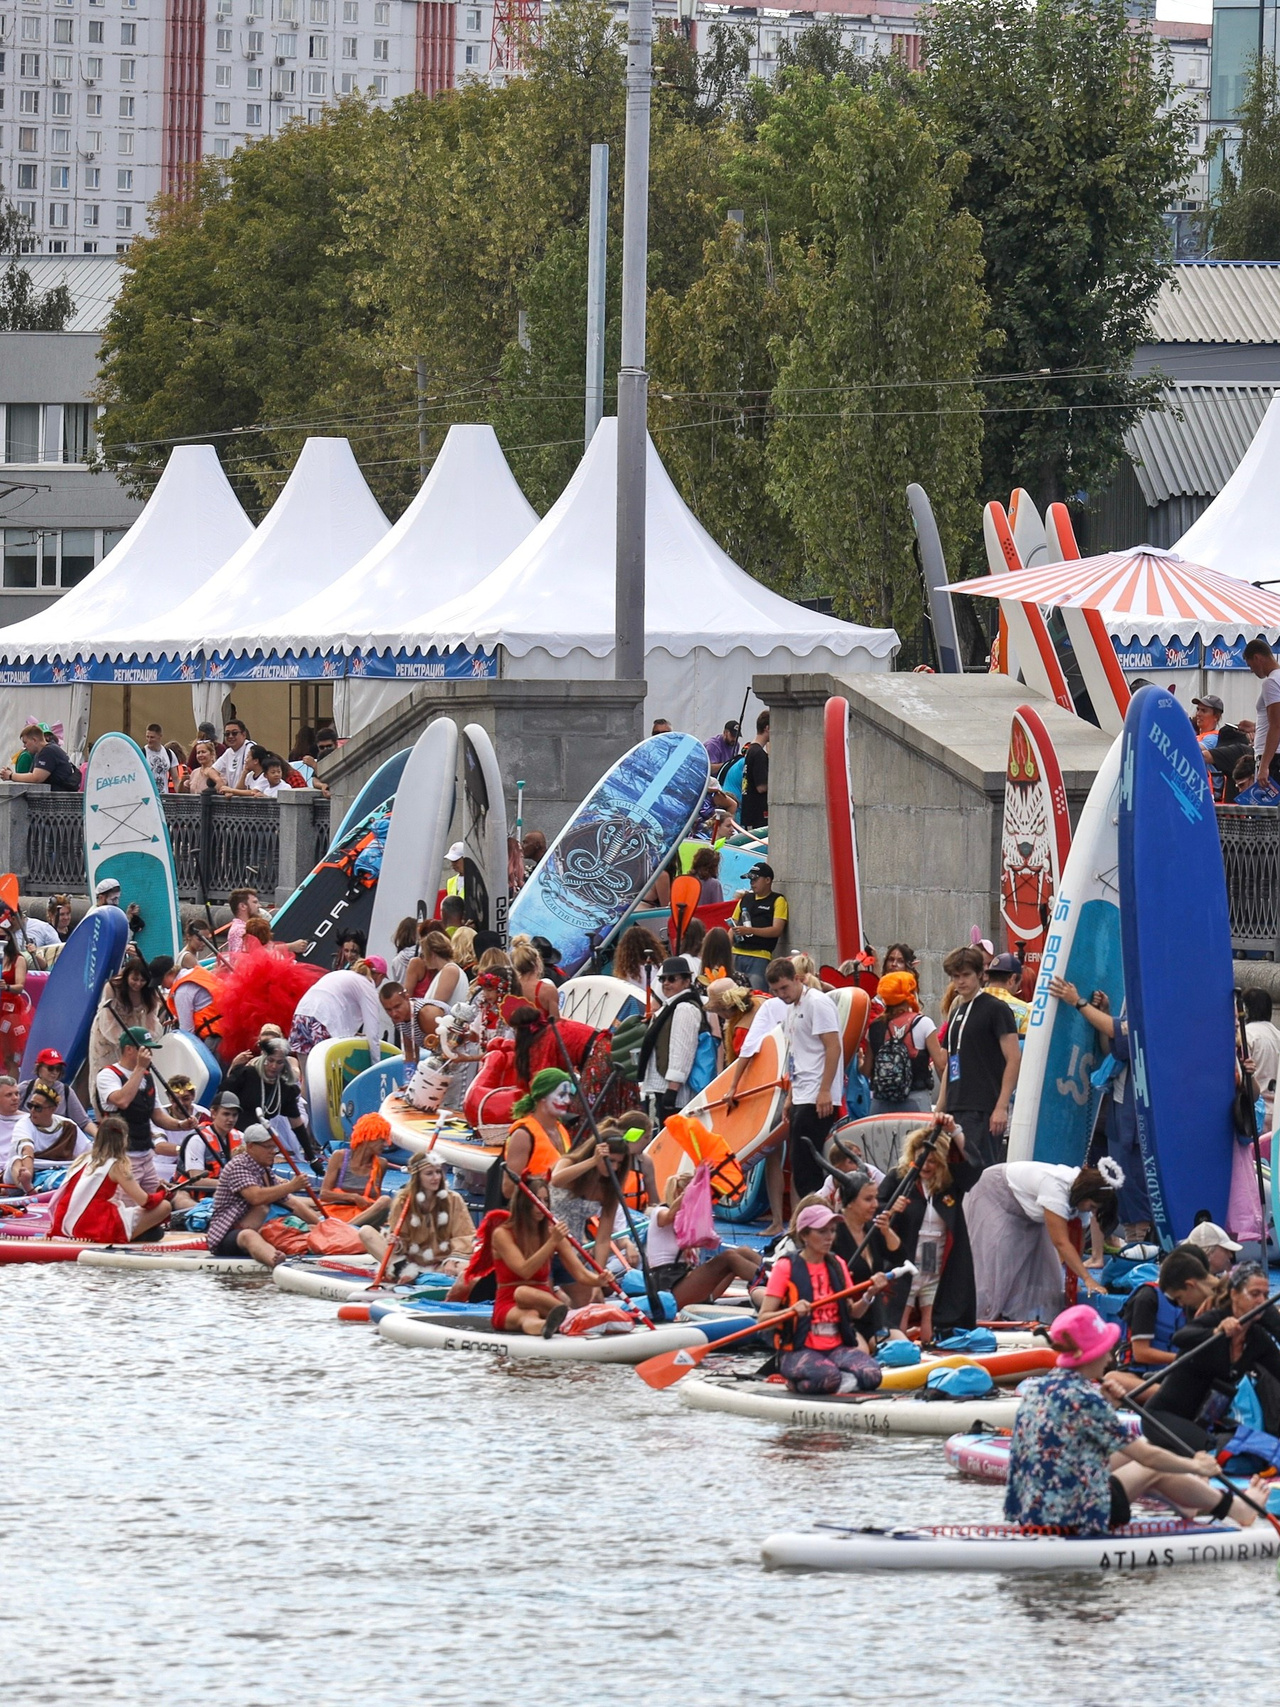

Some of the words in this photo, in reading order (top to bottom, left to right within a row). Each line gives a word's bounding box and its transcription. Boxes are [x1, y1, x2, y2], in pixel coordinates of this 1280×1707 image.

[113, 669, 158, 682] РЕГИСТРАЦИЯ
[395, 663, 445, 677] РЕГИСТРАЦИЯ
[1148, 721, 1210, 803] BRADEX
[1030, 934, 1062, 1027] BOARD
[1143, 1154, 1166, 1223] BRADEX
[1099, 1548, 1175, 1570] ATLAS
